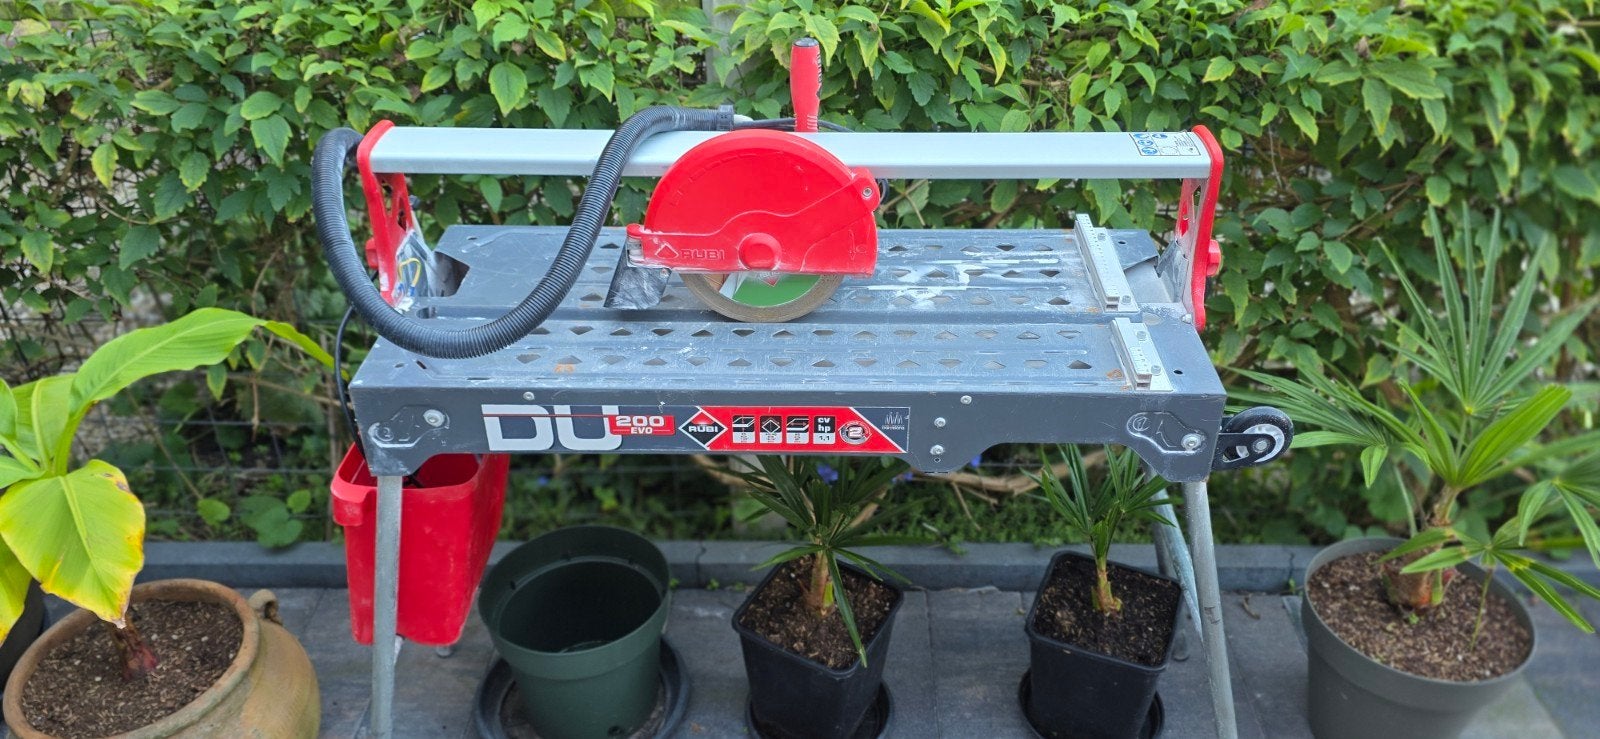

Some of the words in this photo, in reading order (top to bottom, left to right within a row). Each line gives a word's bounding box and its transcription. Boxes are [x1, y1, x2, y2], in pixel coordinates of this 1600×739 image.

[616, 415, 665, 427] 200
[481, 404, 623, 451] DU
[630, 427, 653, 435] EVO
[688, 425, 719, 433] RUBI
[818, 424, 831, 433] hp
[848, 426, 863, 439] 2
